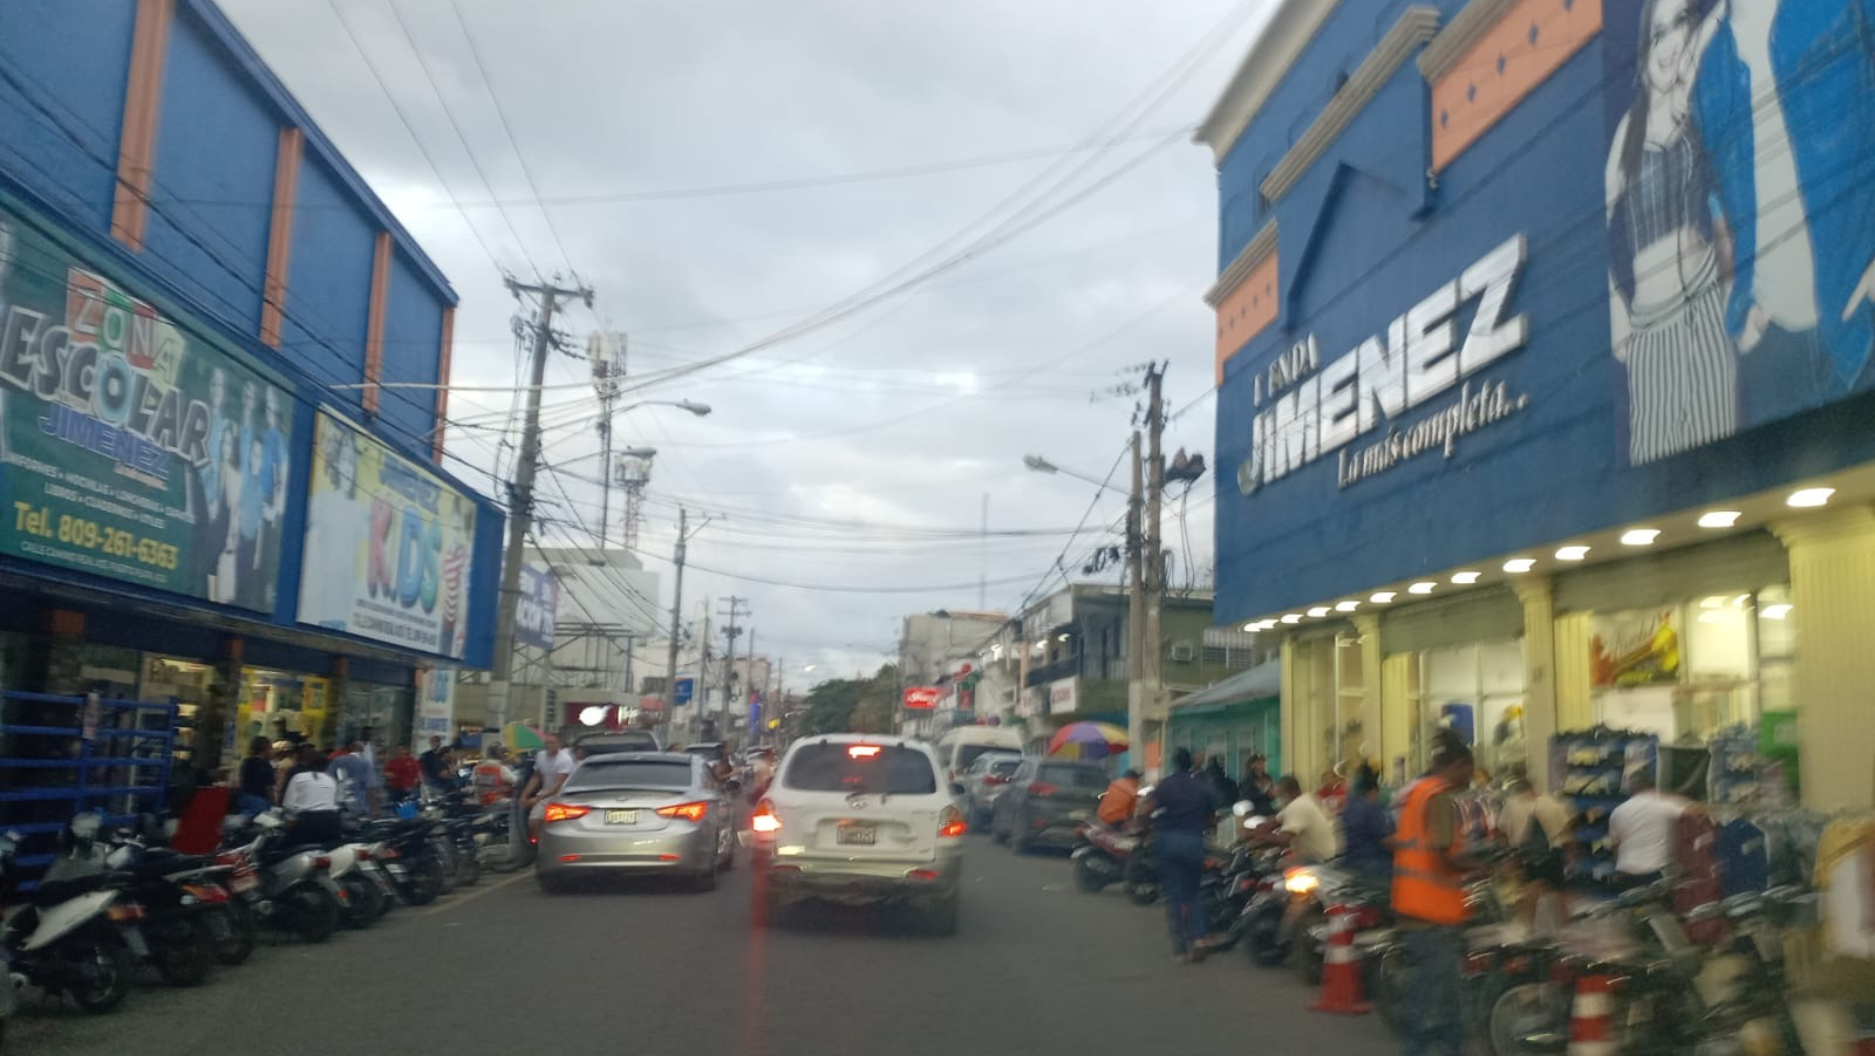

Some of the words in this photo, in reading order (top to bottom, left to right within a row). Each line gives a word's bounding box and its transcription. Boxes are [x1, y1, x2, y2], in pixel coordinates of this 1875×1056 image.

[0, 305, 212, 468] ESCOLAR
[74, 287, 176, 388] ZONA
[1237, 231, 1527, 496] JIMENEZ
[38, 403, 171, 482] JIMENEZ
[14, 501, 53, 538] Tel.
[58, 514, 179, 570] 809-261-6363
[367, 490, 442, 615] KIDS
